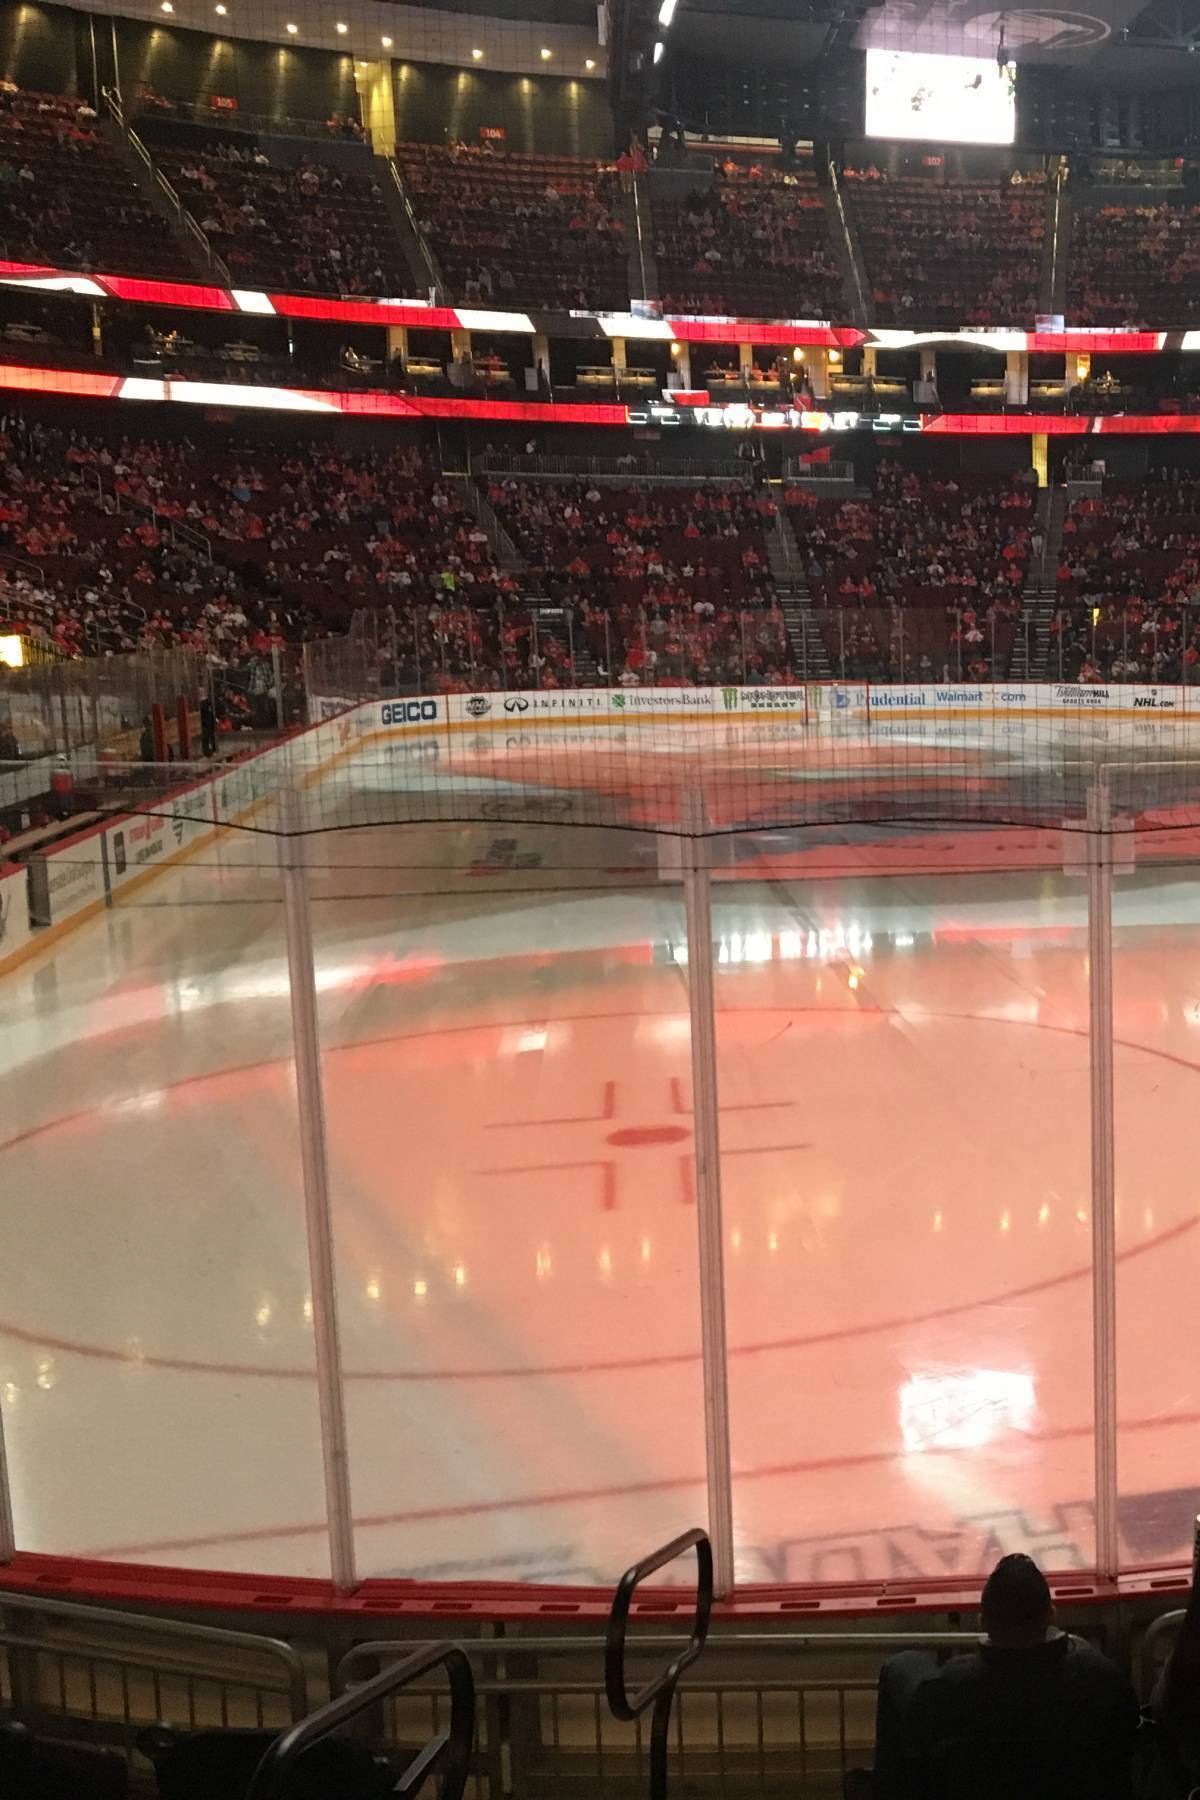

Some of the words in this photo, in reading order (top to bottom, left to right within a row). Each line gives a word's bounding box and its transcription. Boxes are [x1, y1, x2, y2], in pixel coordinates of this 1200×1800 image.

[486, 128, 501, 138] 104
[936, 691, 983, 702] Walmart
[532, 698, 600, 708] INFINITI
[381, 700, 438, 725] GEICO
